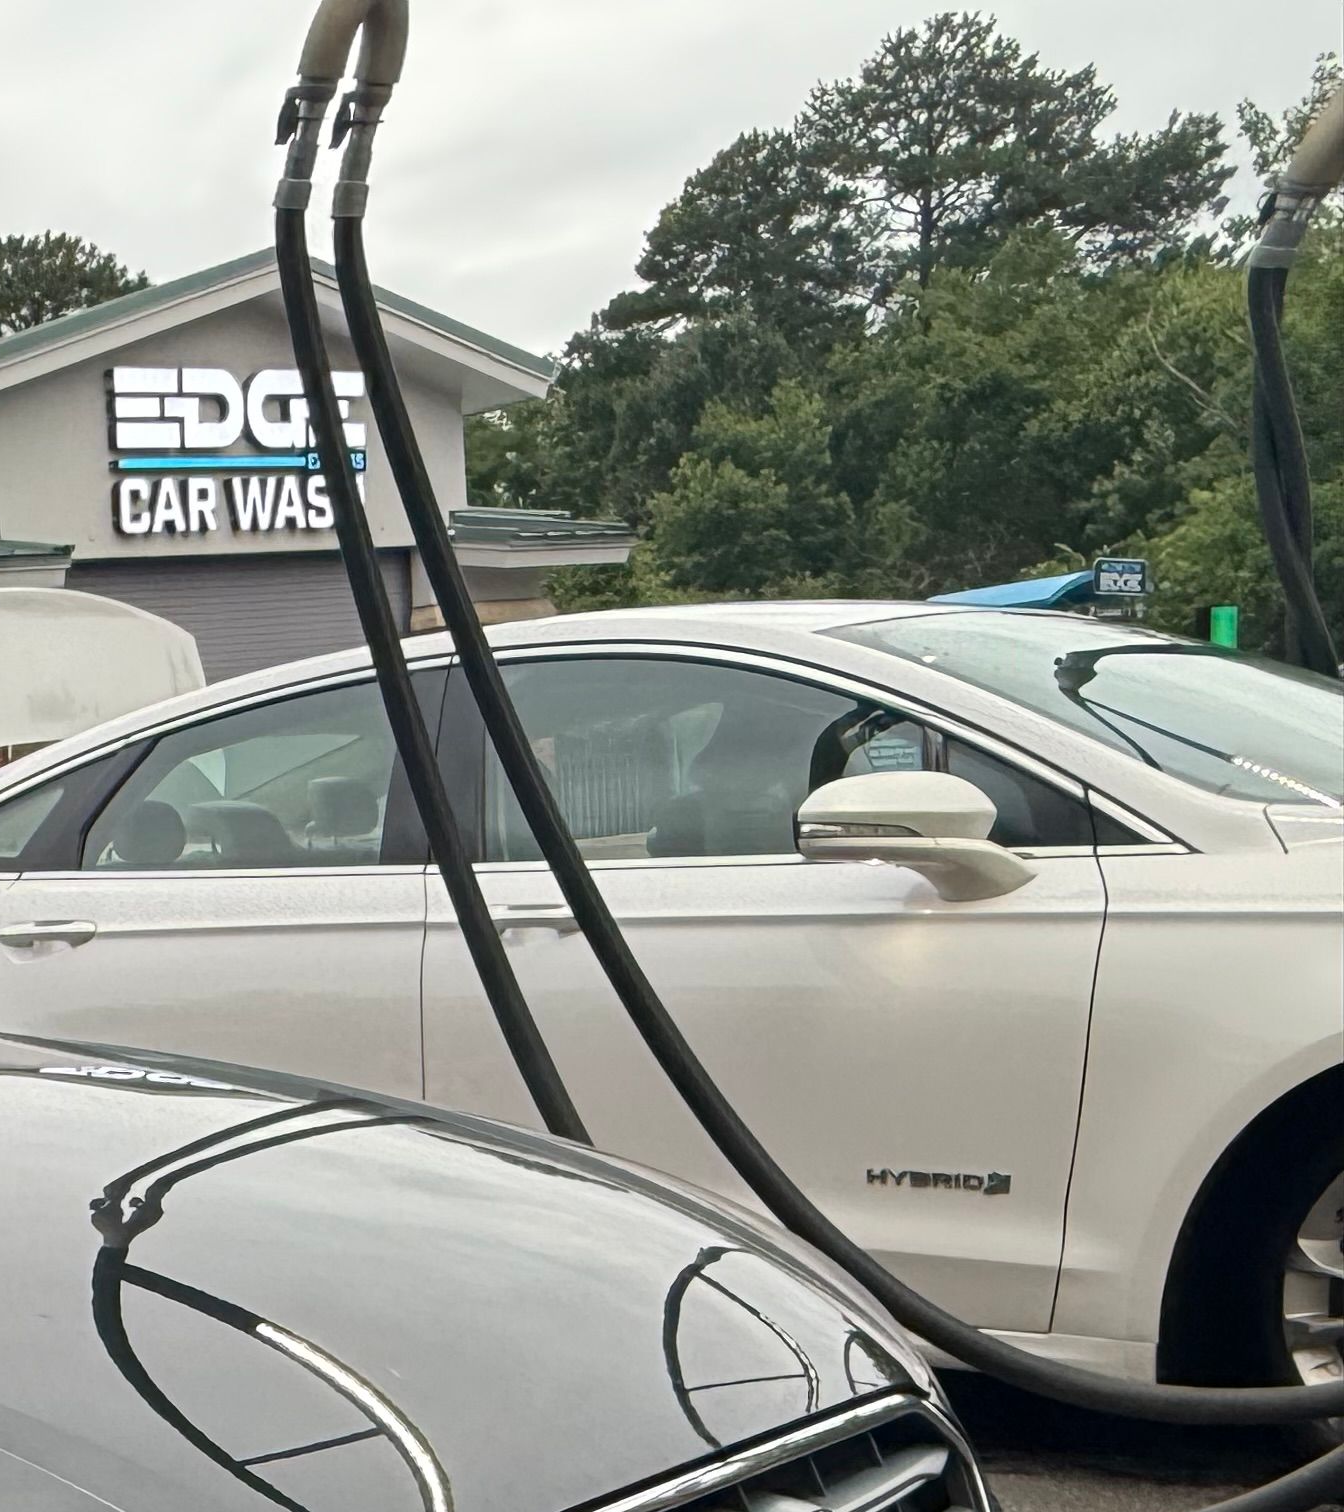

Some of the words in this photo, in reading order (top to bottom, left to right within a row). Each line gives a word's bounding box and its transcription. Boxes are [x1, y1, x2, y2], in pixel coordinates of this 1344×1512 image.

[119, 476, 218, 534] CAR
[232, 474, 365, 532] WAS
[866, 1168, 985, 1192] HYBRID
